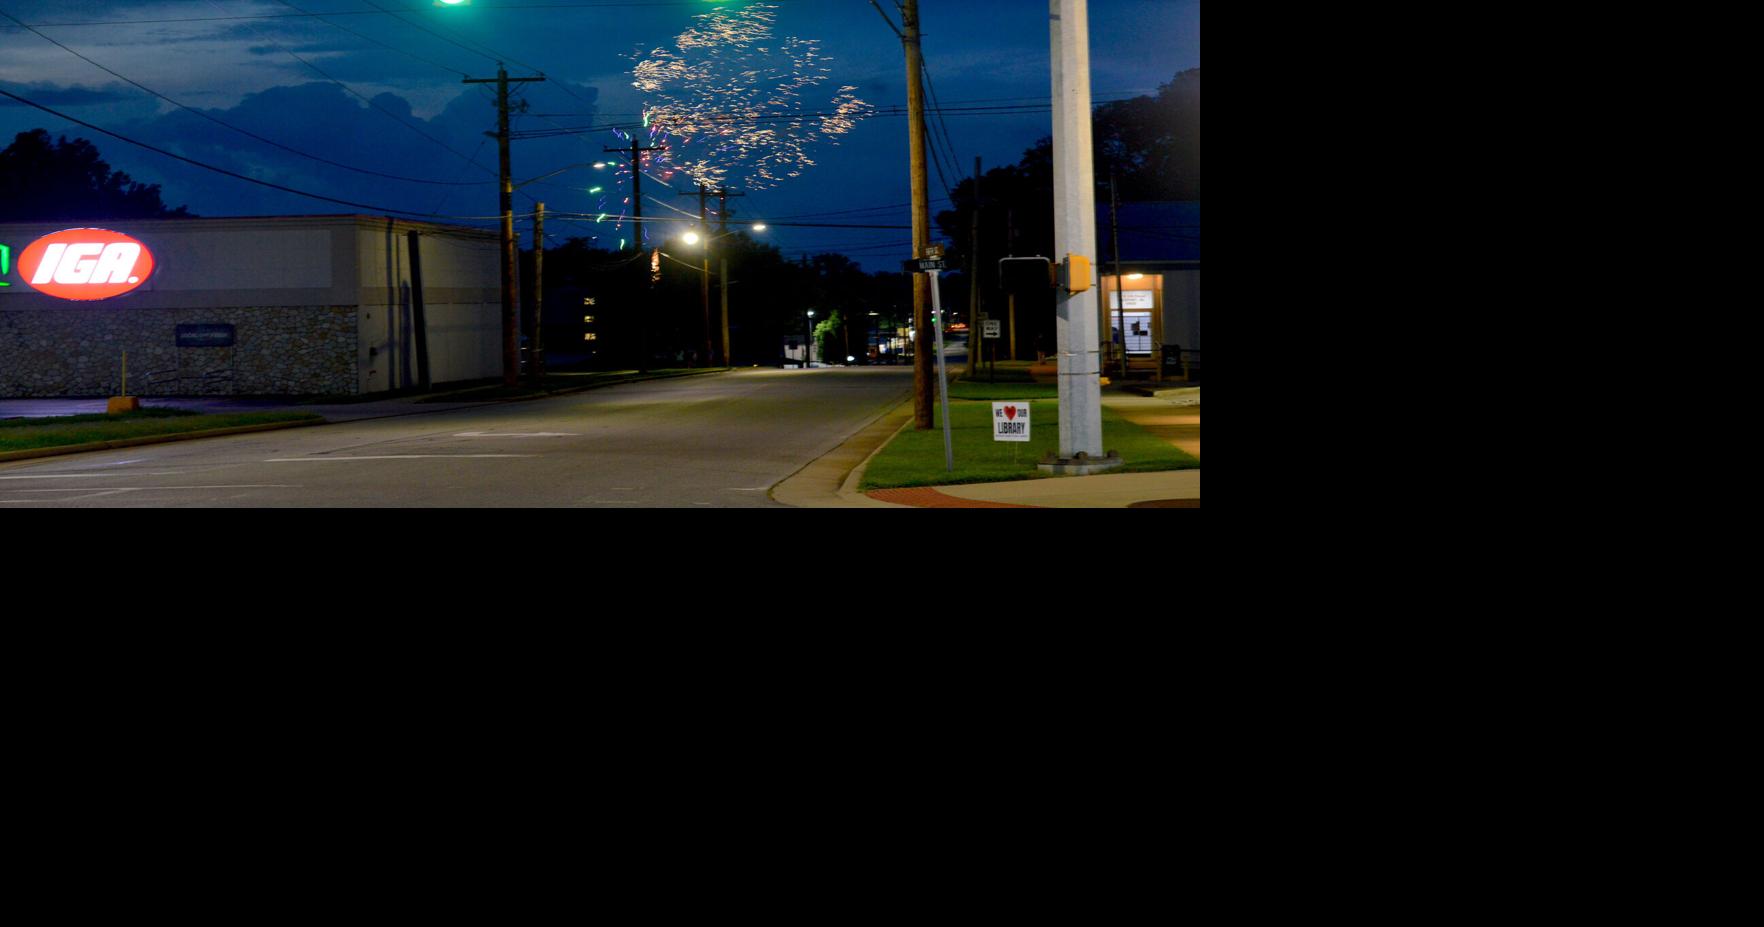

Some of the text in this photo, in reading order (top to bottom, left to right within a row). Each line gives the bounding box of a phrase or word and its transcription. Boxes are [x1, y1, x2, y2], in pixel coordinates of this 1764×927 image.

[919, 260, 936, 269] MAIN
[995, 408, 1027, 417] WE OUR
[997, 421, 1026, 434] LIBRARY
